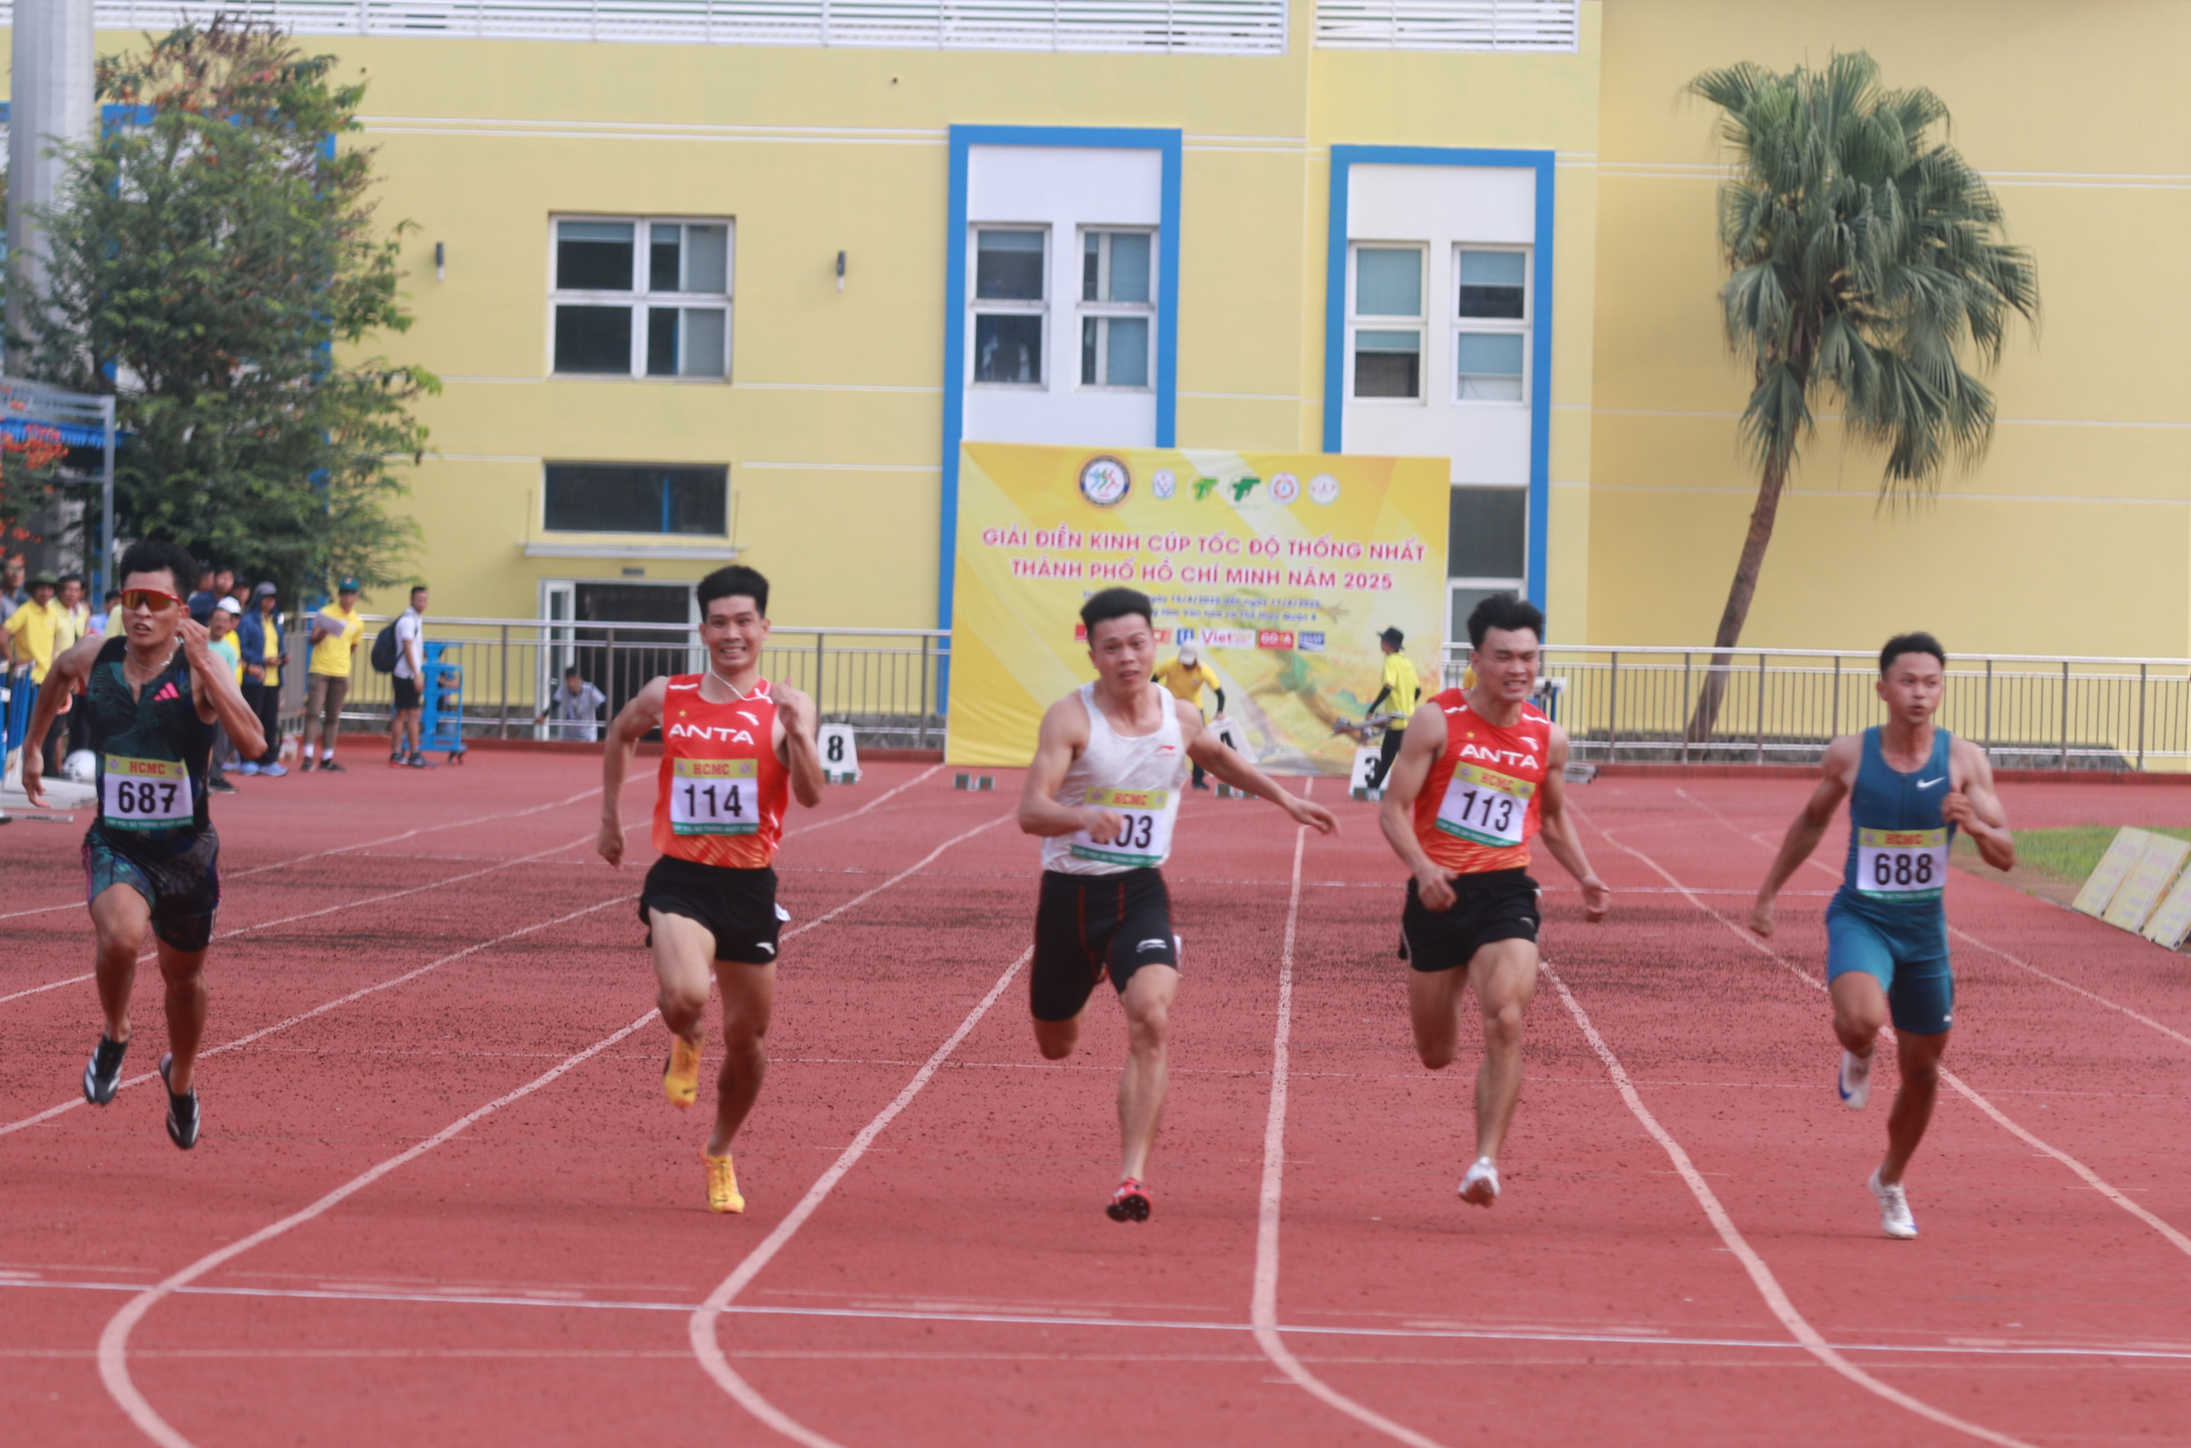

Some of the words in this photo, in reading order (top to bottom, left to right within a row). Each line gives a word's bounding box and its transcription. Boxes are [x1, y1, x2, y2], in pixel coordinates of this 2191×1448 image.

[982, 523, 1028, 547] GIẢI
[1035, 522, 1083, 549] ĐIỀN
[1090, 532, 1140, 550] KINH
[1148, 530, 1191, 553] CÚP
[1198, 530, 1241, 556] TỐC
[1250, 535, 1281, 561] ĐỘ
[1288, 533, 1363, 559] THỐNG
[1369, 536, 1426, 562] NHẤT
[1012, 556, 1083, 579] THÀNH
[1090, 557, 1137, 581] PHỐ
[1142, 557, 1173, 582] HỒ
[1181, 562, 1218, 583] CHÍ
[1226, 566, 1280, 586] MINH
[1288, 566, 1336, 588] NĂM
[1343, 571, 1393, 591] 2025
[668, 723, 755, 745] ANTA
[828, 735, 844, 762] 8
[129, 761, 166, 775] HCMC
[693, 763, 730, 775] HCMC
[1459, 744, 1539, 770] ANTA
[118, 780, 177, 814] 687
[684, 784, 742, 818] 114
[1462, 790, 1513, 832] 113
[1091, 814, 1153, 849] 03
[1875, 852, 1933, 885] 688
